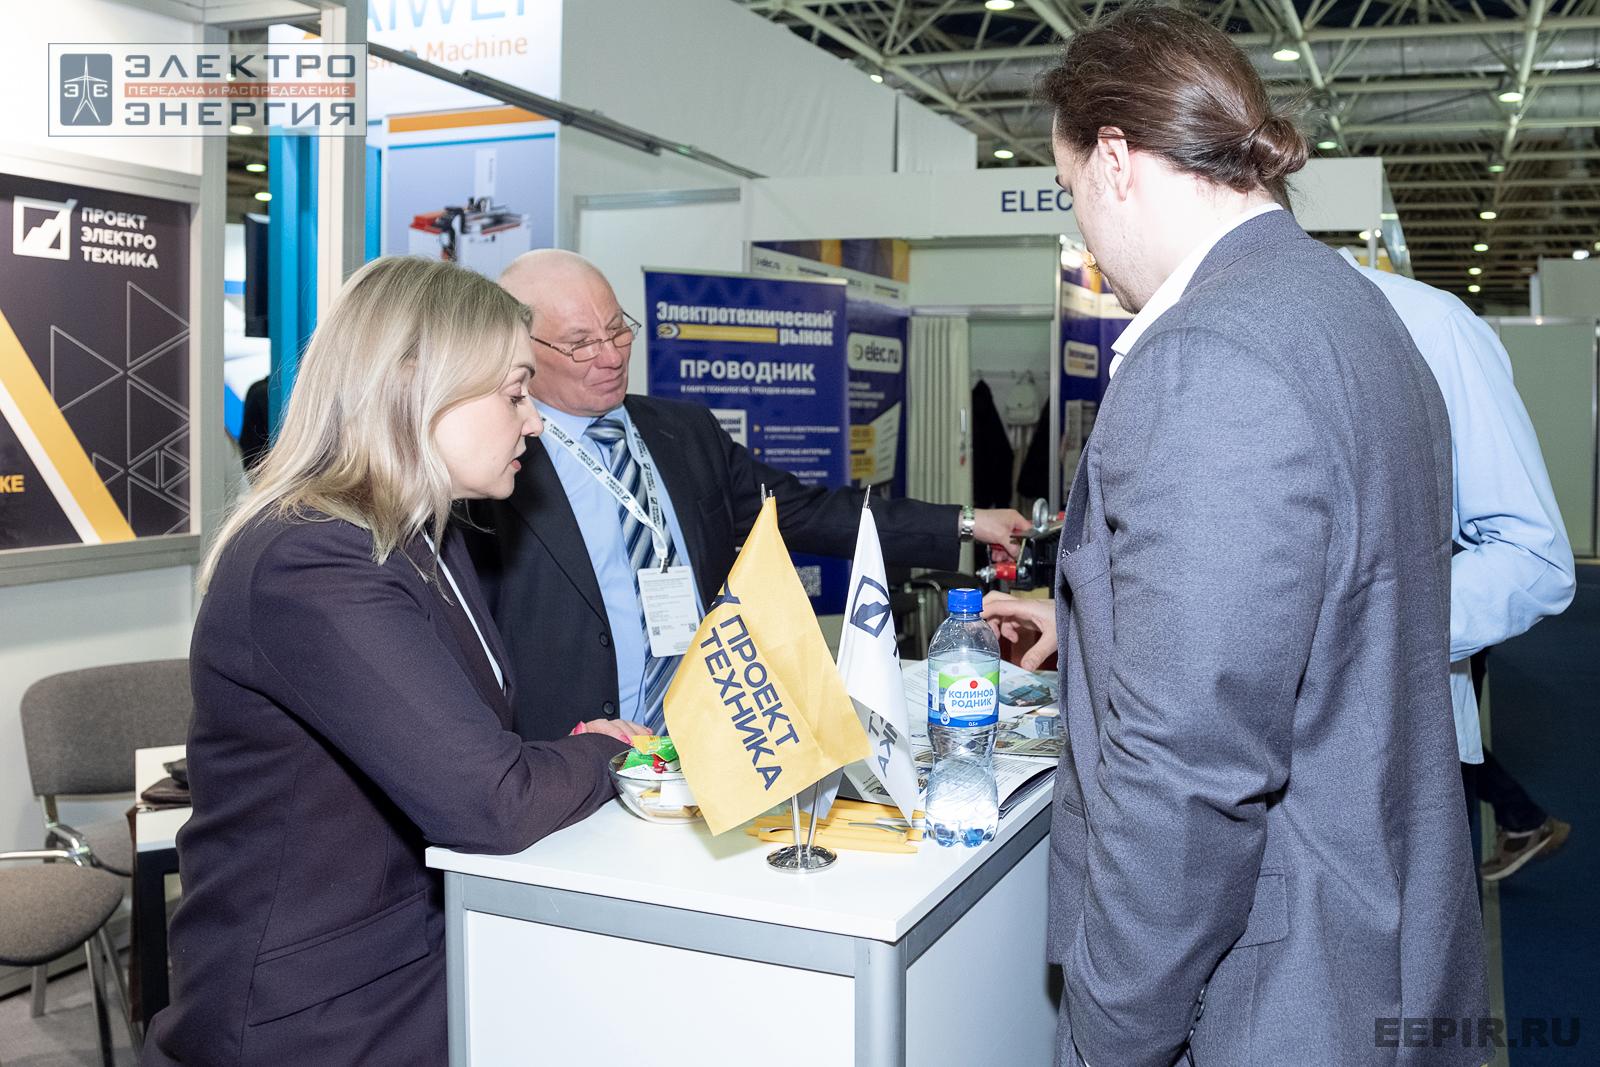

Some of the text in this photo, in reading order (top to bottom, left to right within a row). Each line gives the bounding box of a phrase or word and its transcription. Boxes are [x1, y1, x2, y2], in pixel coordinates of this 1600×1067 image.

[425, 35, 529, 63] Machine
[1001, 189, 1072, 213] ELEC
[81, 206, 147, 230] ПРОЕКТ
[80, 226, 157, 250] ЭЛЕКТРО
[80, 245, 159, 270] ТЕХНИКА
[656, 301, 833, 328] Электротехнический
[779, 328, 833, 346] рынок
[864, 341, 899, 364] elec.ru
[680, 358, 816, 384] ПРОВОДНИК
[719, 614, 800, 748] ПРОЕКТ
[699, 625, 783, 791] ТЕХНИКА
[951, 697, 992, 709] РОДНИК
